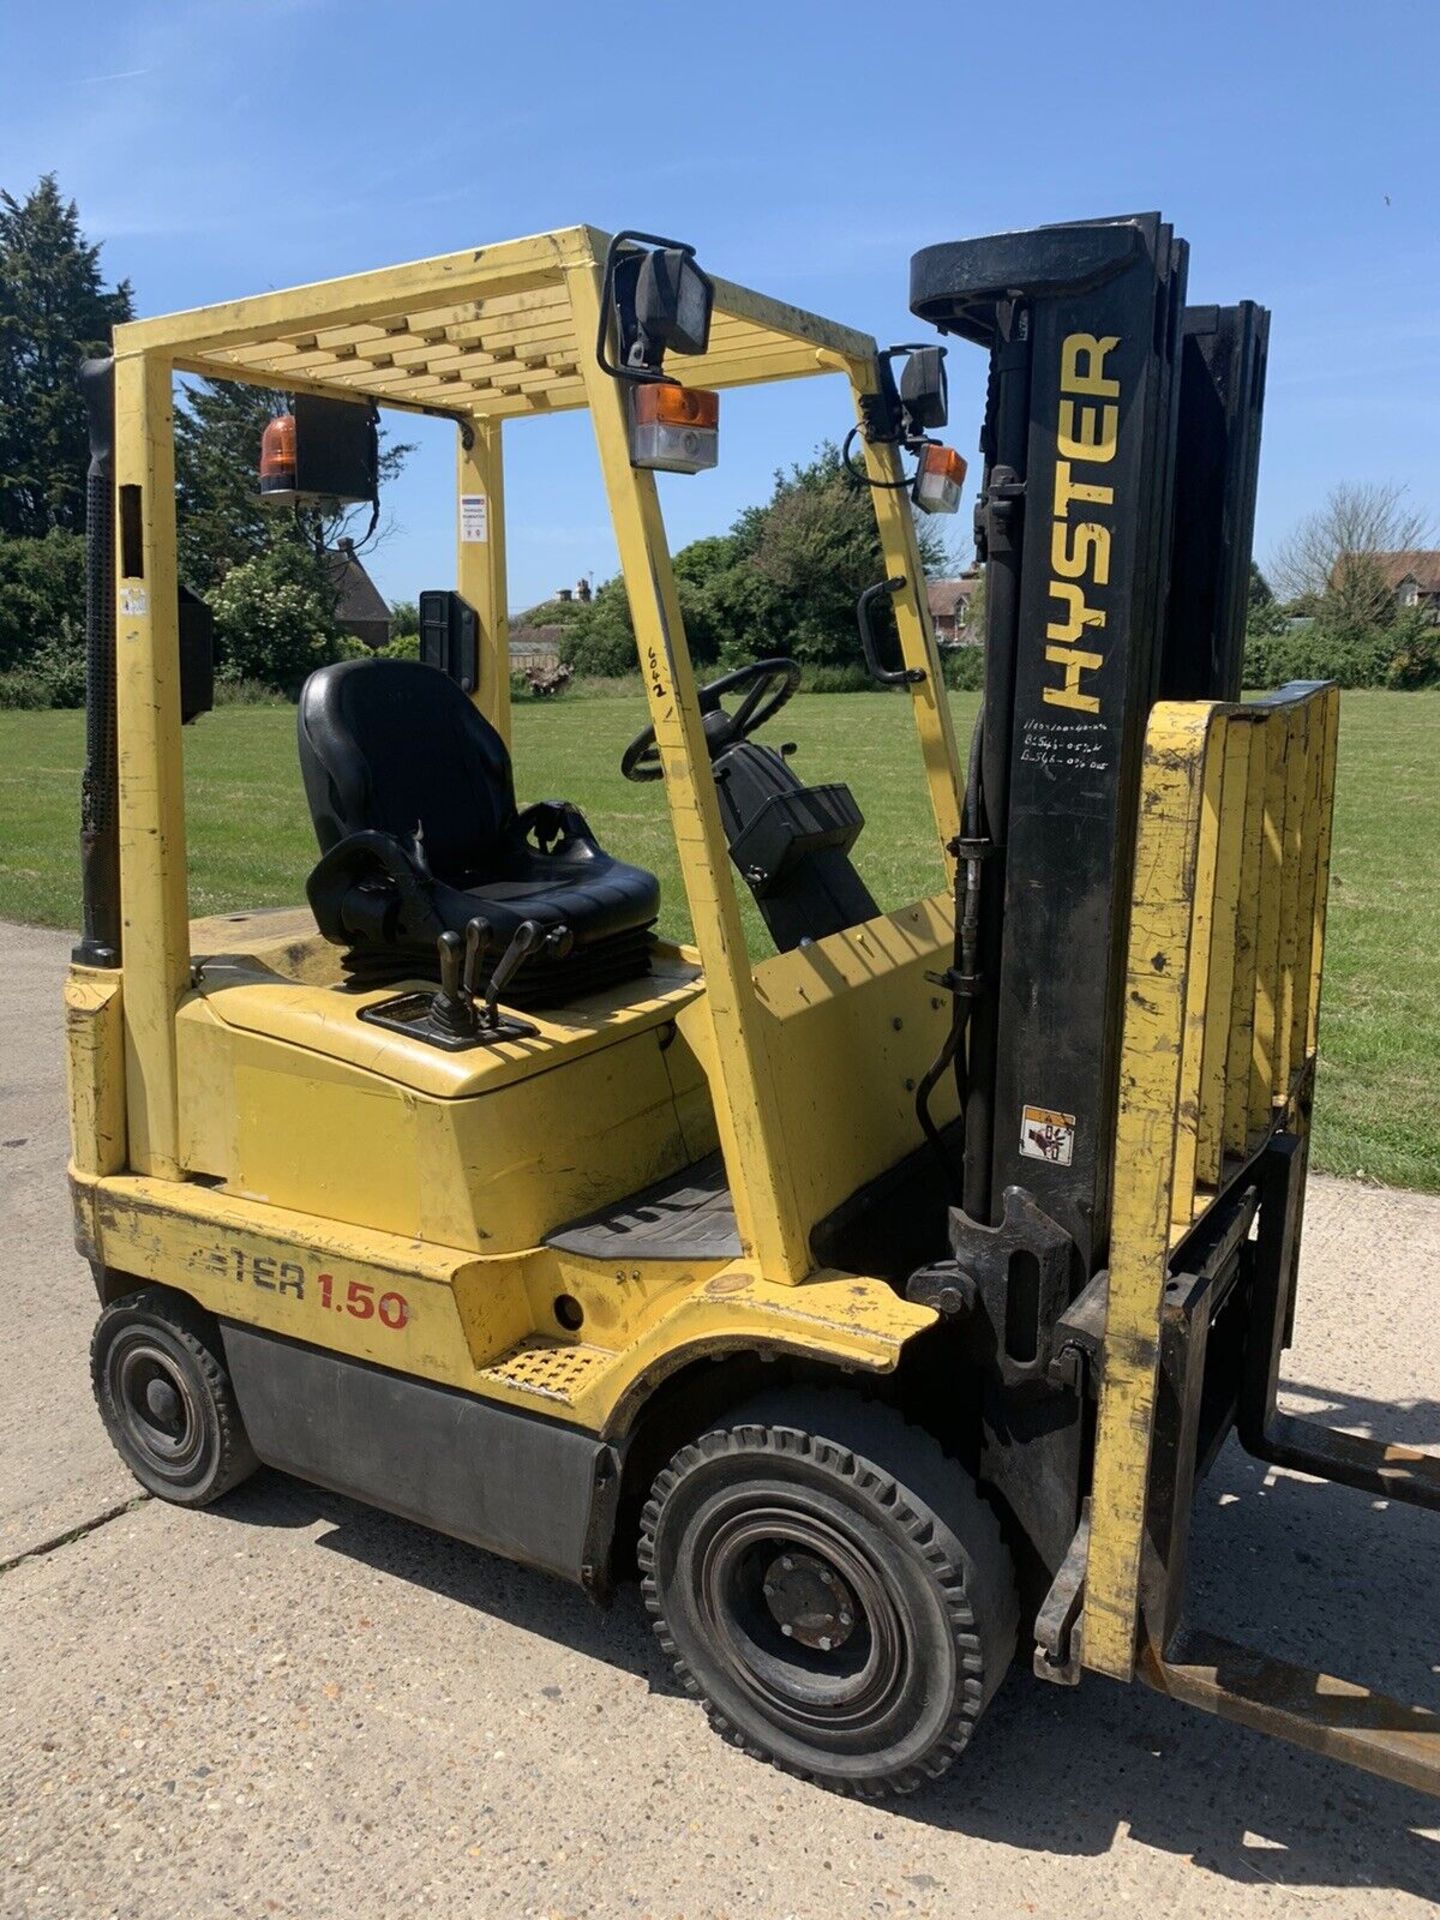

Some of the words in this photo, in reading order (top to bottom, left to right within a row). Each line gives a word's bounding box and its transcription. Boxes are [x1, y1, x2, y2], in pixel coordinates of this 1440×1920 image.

[1043, 332, 1121, 714] HYSTER
[648, 646, 667, 698] 6042
[317, 1273, 412, 1329] 1.50
